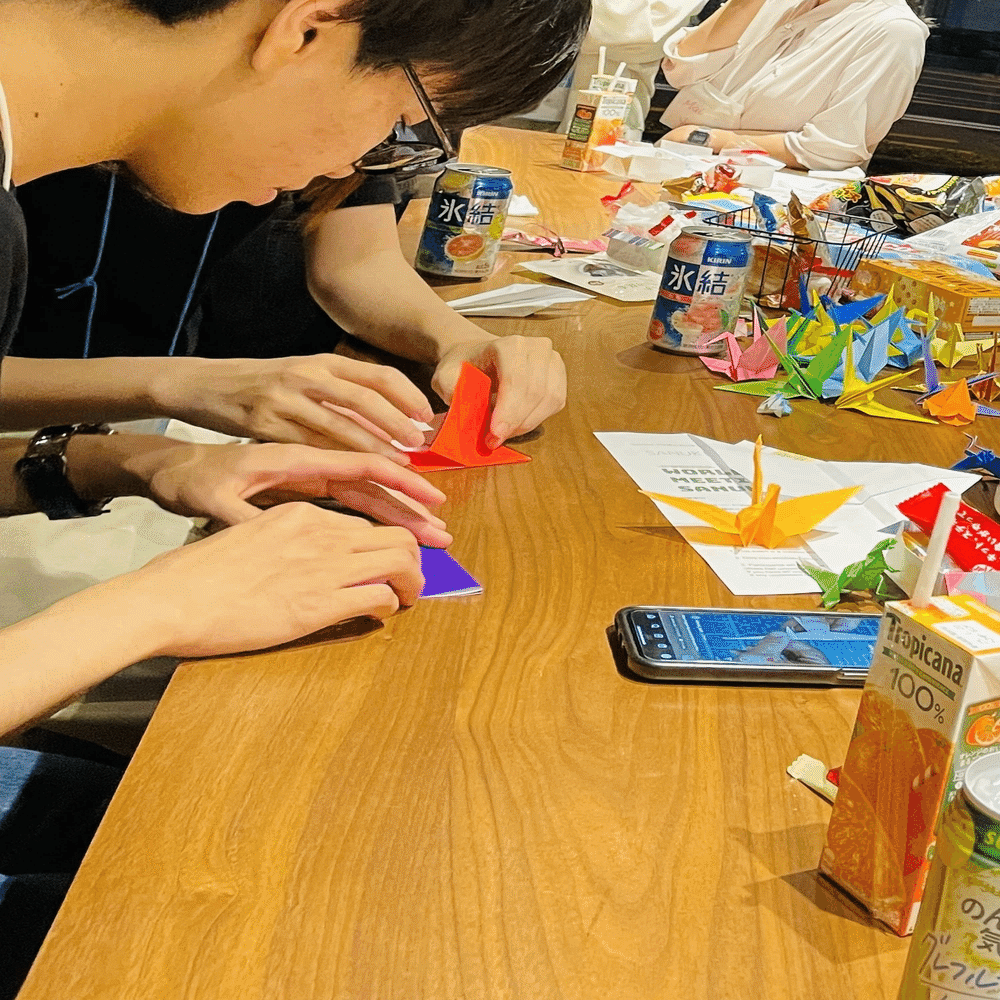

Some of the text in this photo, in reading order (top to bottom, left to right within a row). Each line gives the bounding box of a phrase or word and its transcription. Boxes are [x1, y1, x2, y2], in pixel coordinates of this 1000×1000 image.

[437, 197, 497, 226] 氷結
[706, 256, 733, 265] KIRIN
[667, 263, 731, 296] 氷結
[953, 521, 998, 562] キット、ステ
[885, 611, 965, 687] Tropicana
[890, 667, 946, 725] 100%
